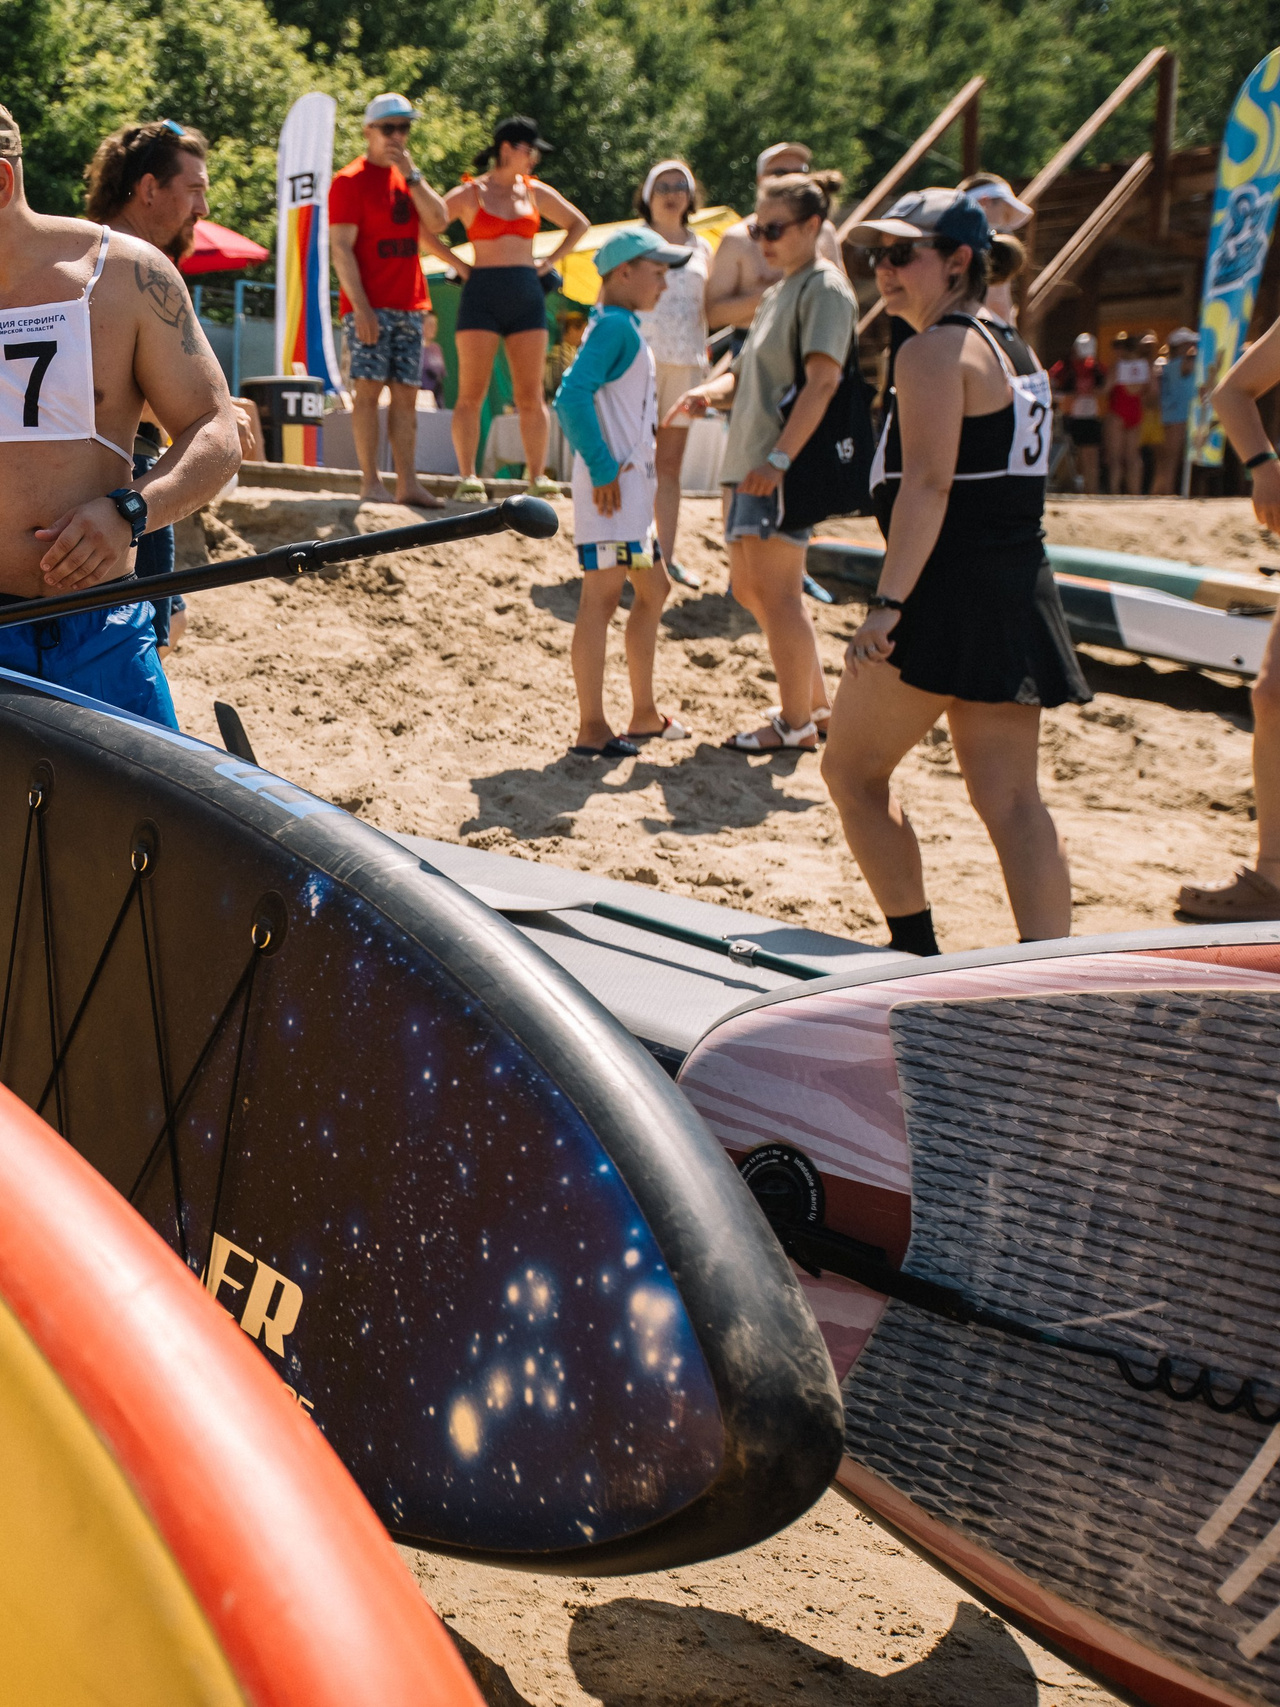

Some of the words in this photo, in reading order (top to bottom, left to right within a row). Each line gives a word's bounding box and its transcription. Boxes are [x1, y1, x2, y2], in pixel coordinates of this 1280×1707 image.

[17, 314, 66, 327] СЕРФИНГА
[26, 324, 54, 333] ОБЛАСТИ
[1023, 400, 1046, 467] 3
[793, 1156, 815, 1187] Inflatable
[810, 1188, 818, 1211] Stand
[200, 1231, 304, 1359] ER
